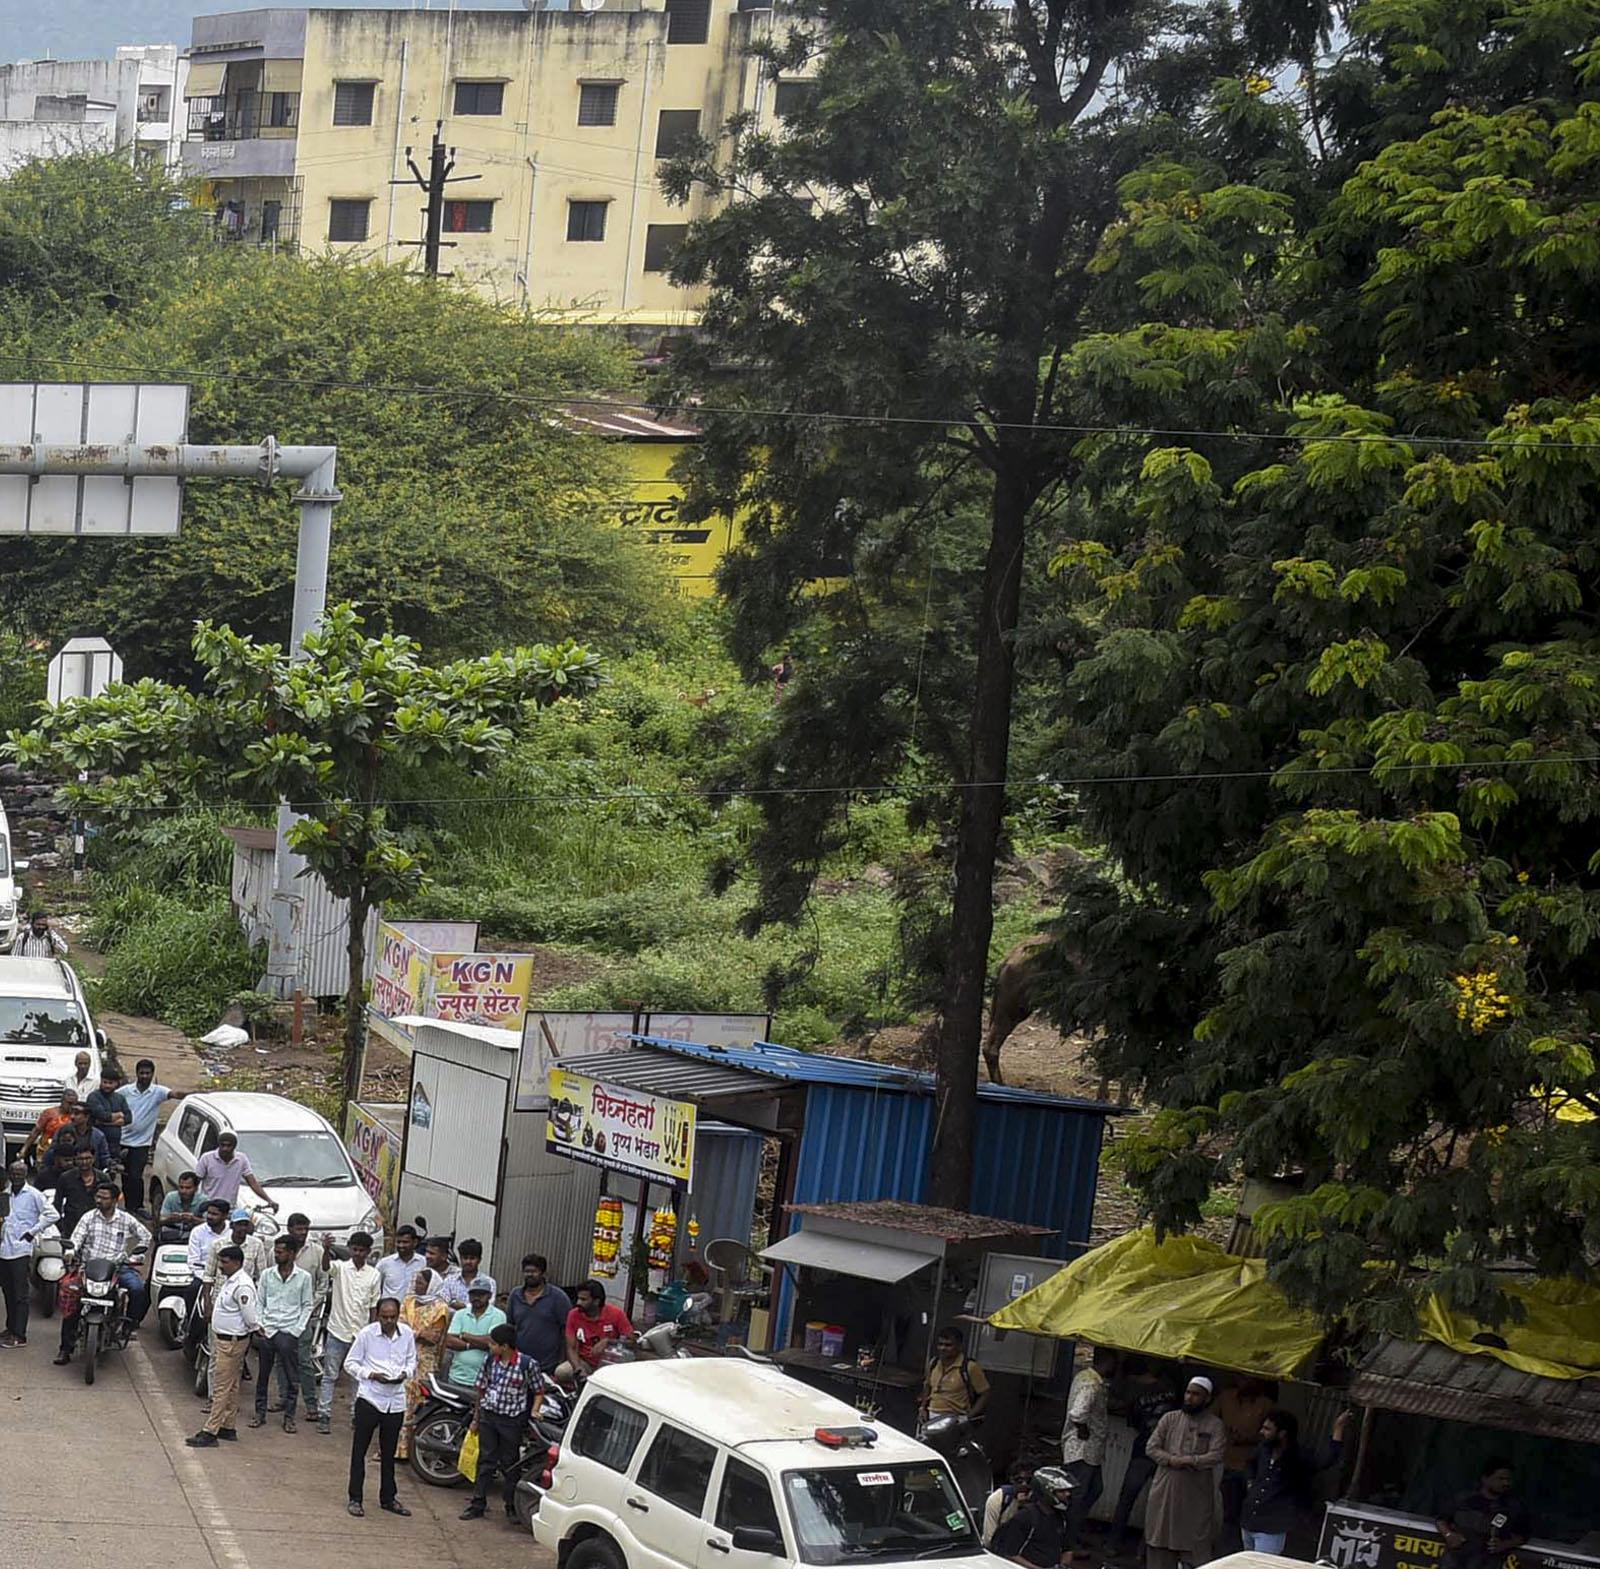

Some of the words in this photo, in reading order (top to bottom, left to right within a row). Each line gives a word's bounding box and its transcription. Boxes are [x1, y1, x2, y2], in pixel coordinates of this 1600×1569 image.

[451, 961, 514, 984] KGN
[435, 993, 477, 1019] ज्यूस
[482, 988, 522, 1014] सेंटर
